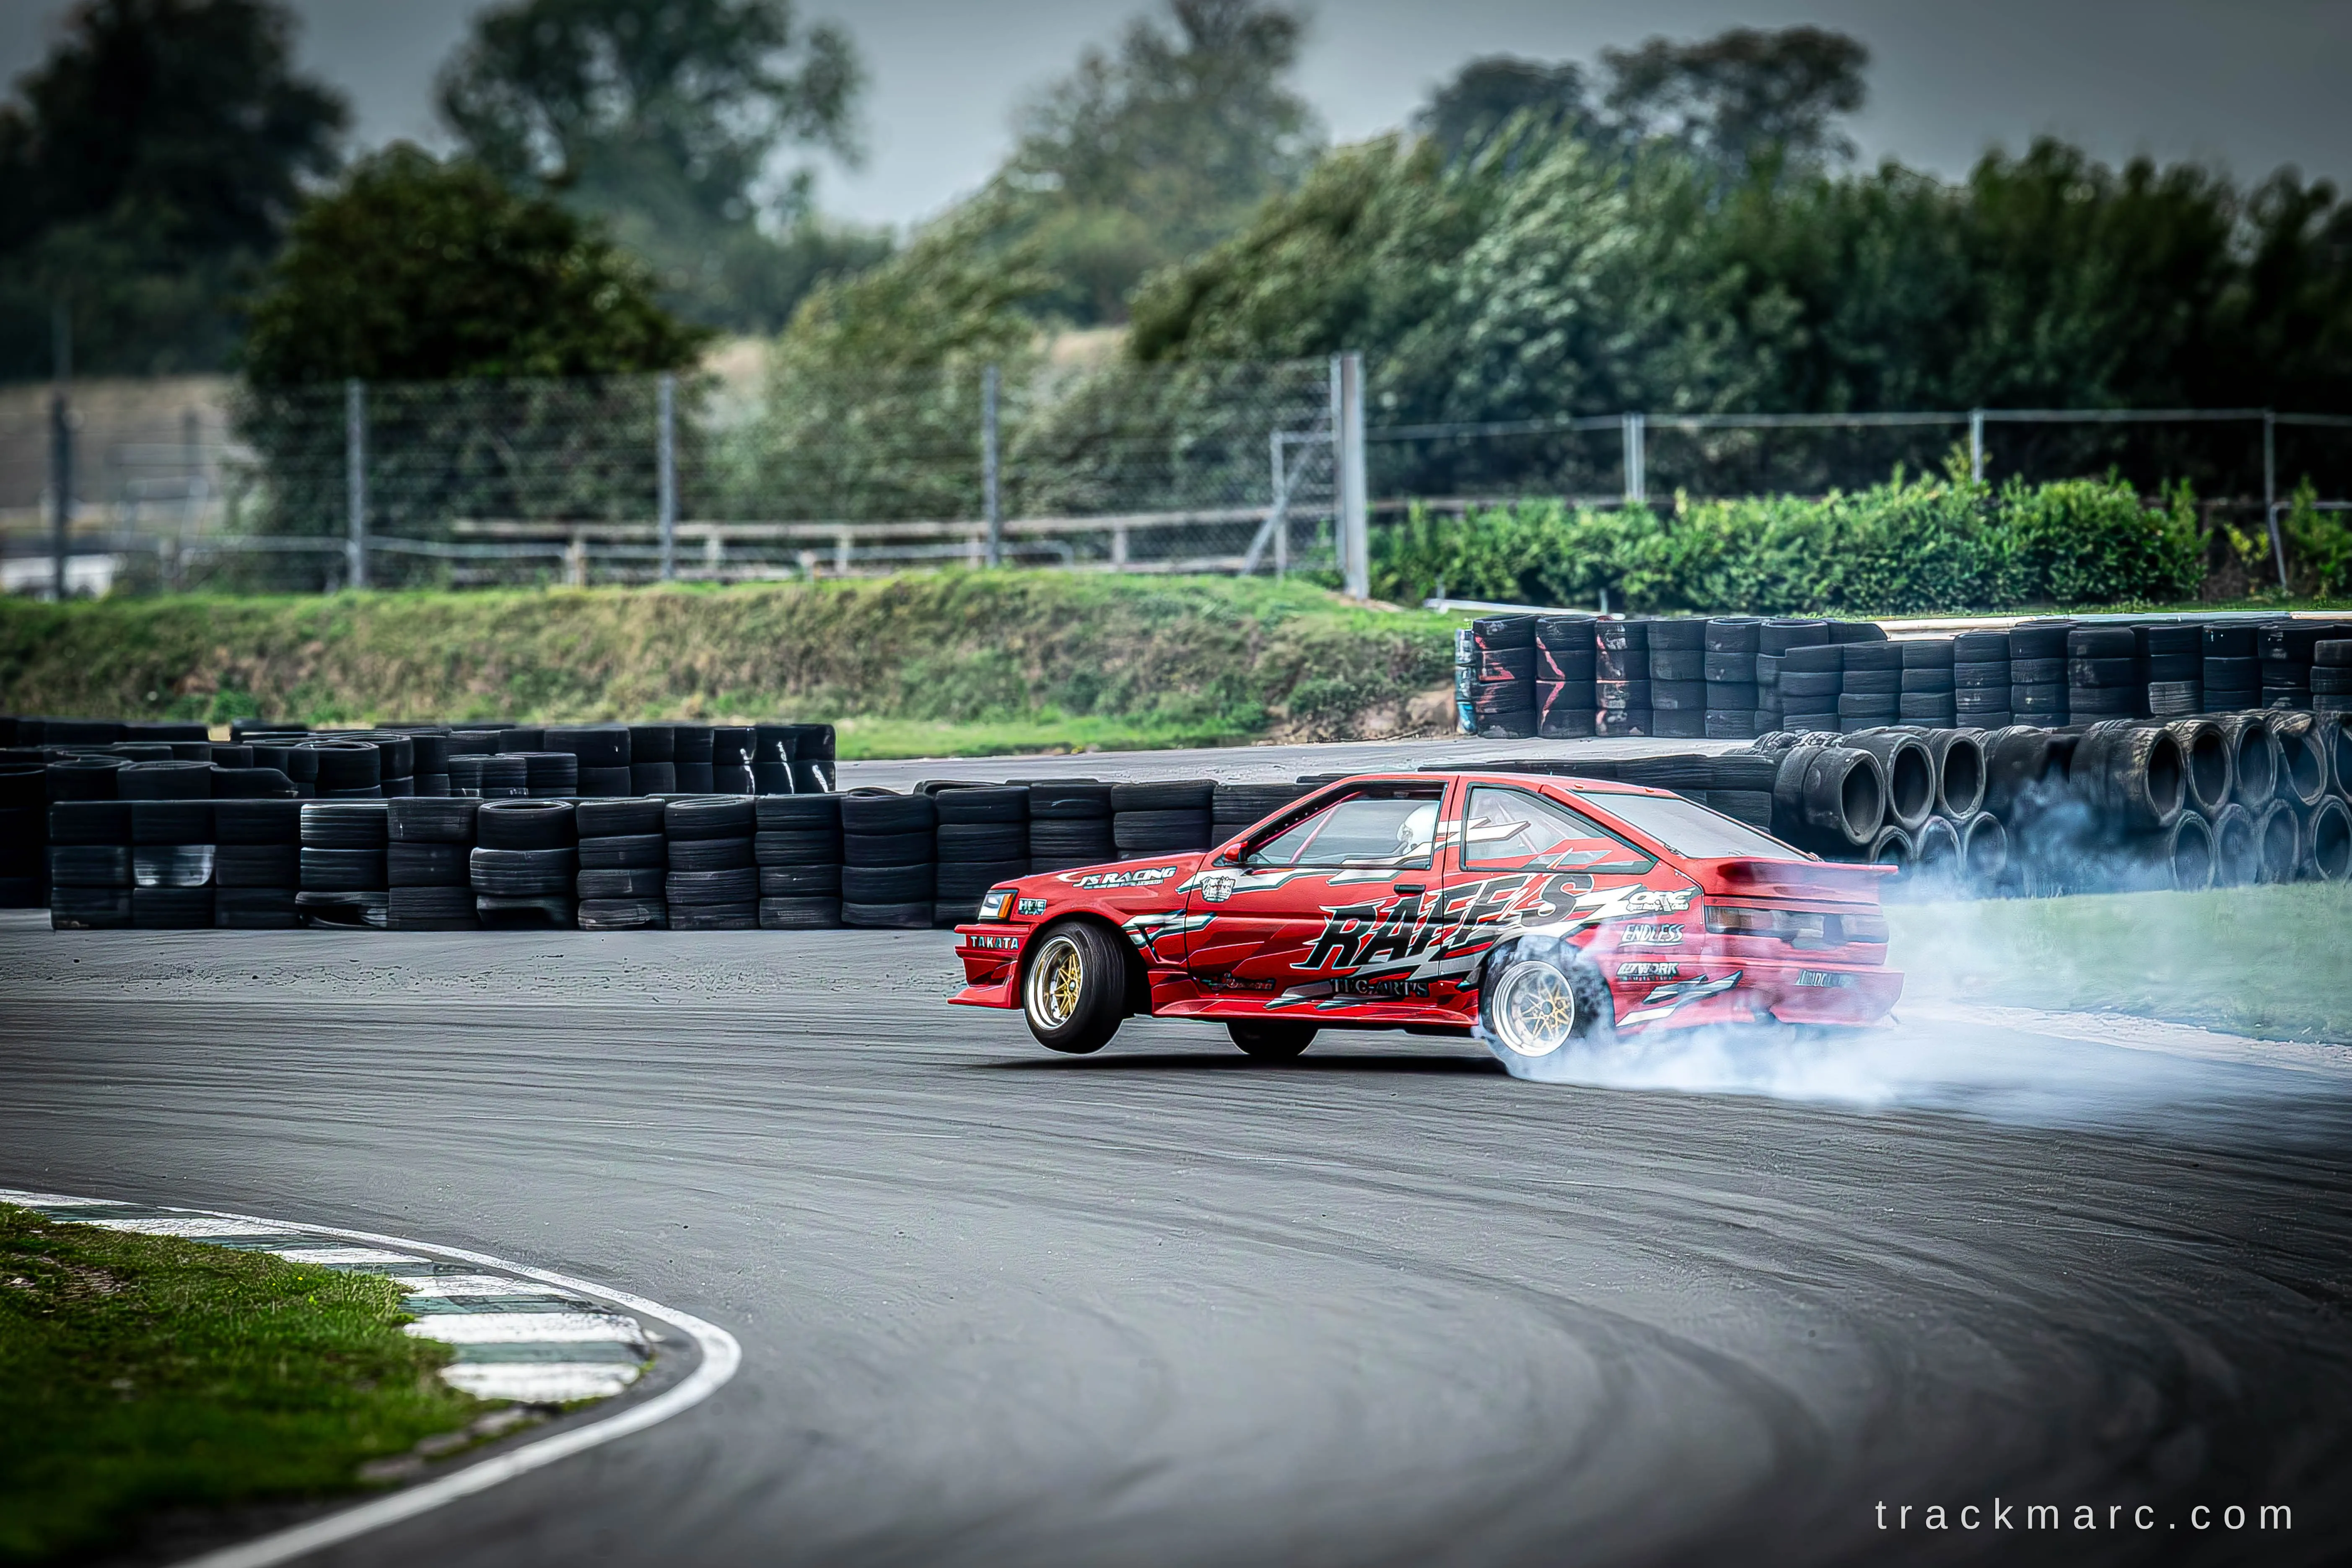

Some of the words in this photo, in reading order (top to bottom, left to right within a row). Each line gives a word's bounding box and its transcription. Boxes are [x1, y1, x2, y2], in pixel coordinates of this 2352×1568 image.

[1102, 867, 1177, 884] RACING
[1621, 924, 1686, 942] ENDLESS
[970, 936, 1019, 950] TAKATA
